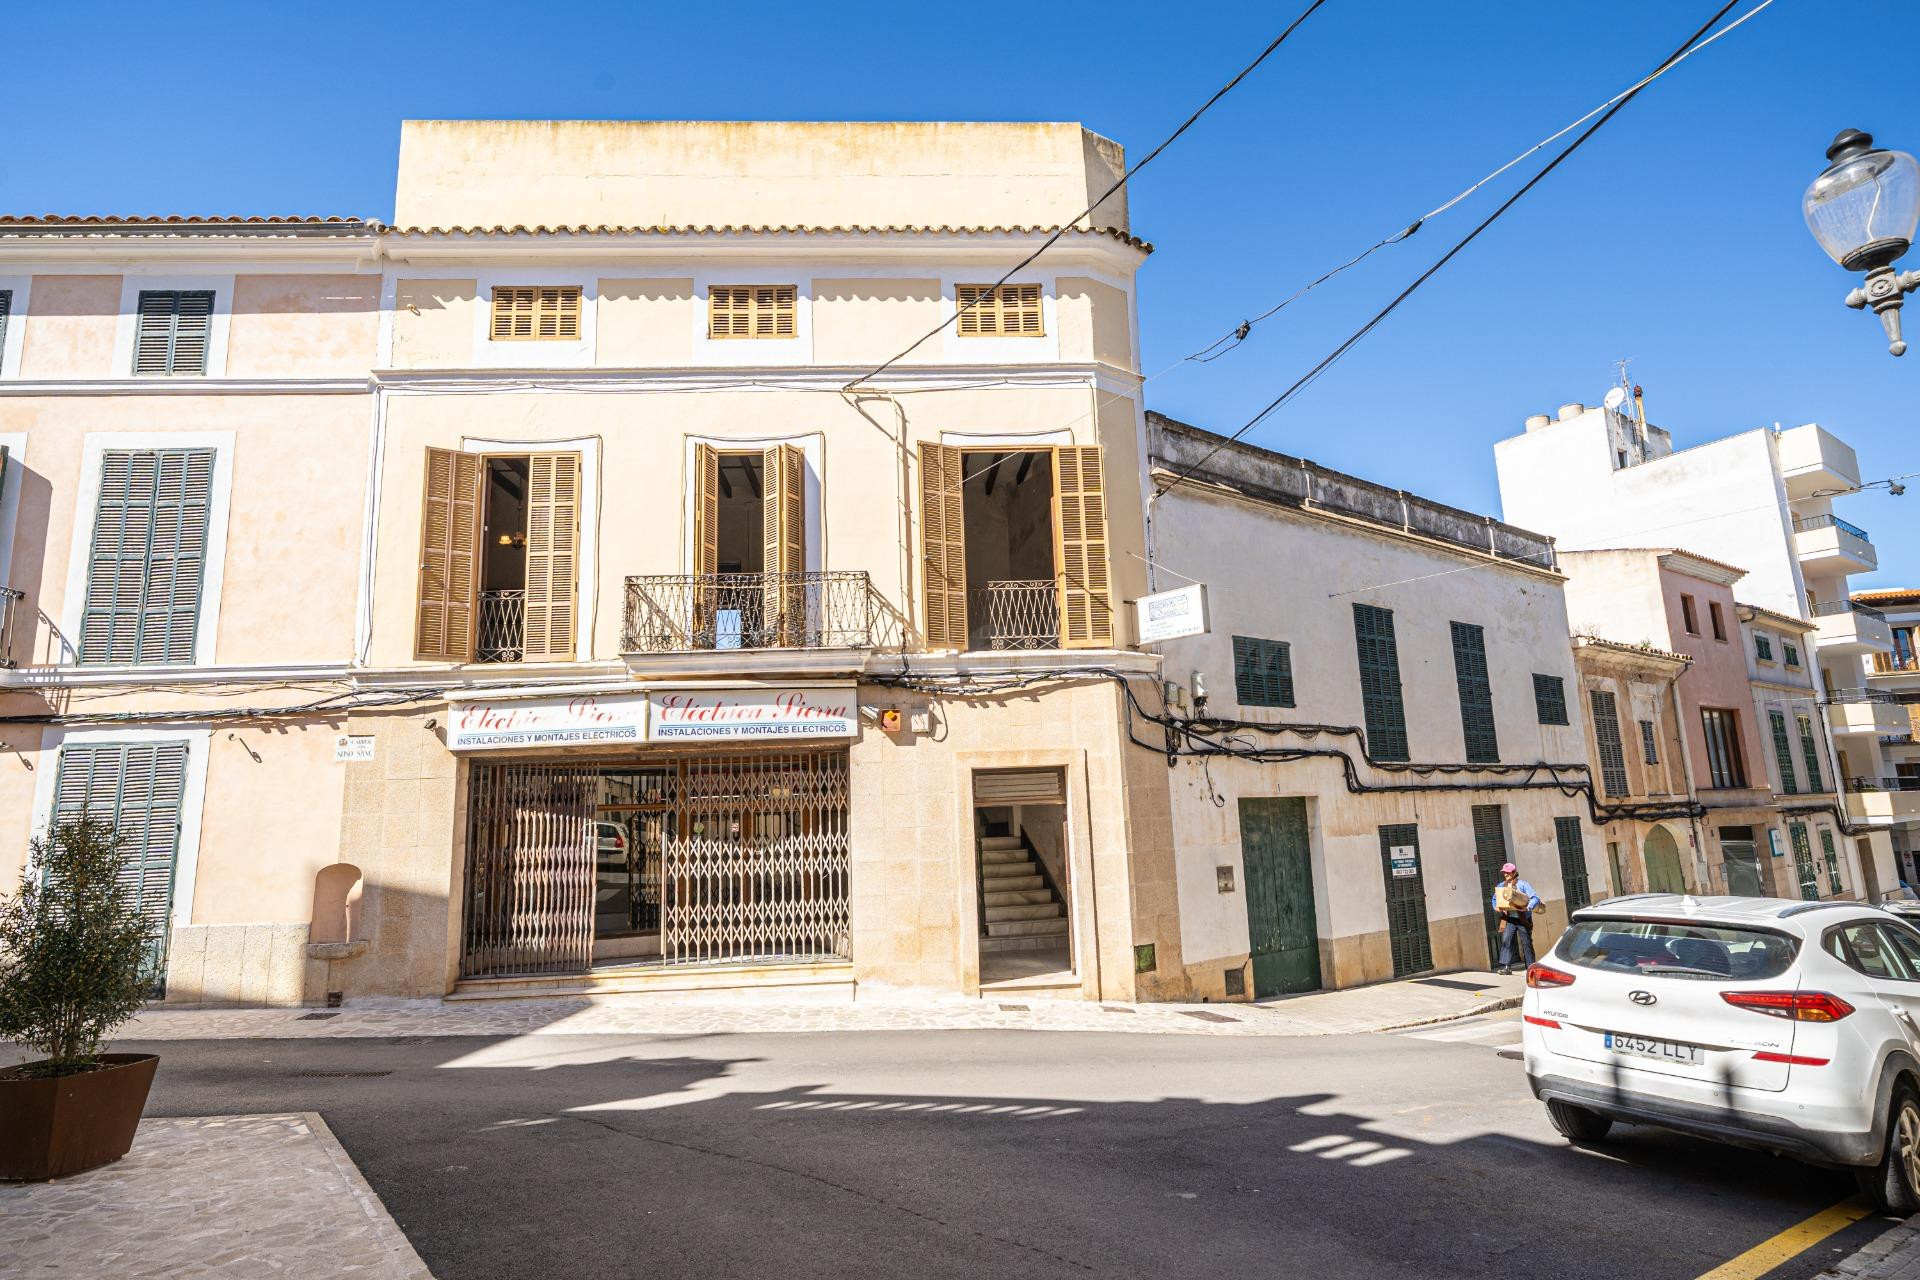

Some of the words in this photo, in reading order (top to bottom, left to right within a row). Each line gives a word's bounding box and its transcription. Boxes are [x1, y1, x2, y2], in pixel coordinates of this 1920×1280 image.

[457, 735, 525, 746] INSTALACIONES
[527, 734, 533, 743] Y
[534, 732, 580, 742] MONTAJES
[582, 729, 637, 740] ELECTRICOS
[658, 727, 731, 737] INSTALACIONES
[733, 727, 740, 735] Y
[741, 726, 790, 735] MONTAJES
[791, 724, 847, 733] ELECTRICOS
[1615, 1034, 1657, 1054] 6452
[1663, 1041, 1697, 1060] LLY
